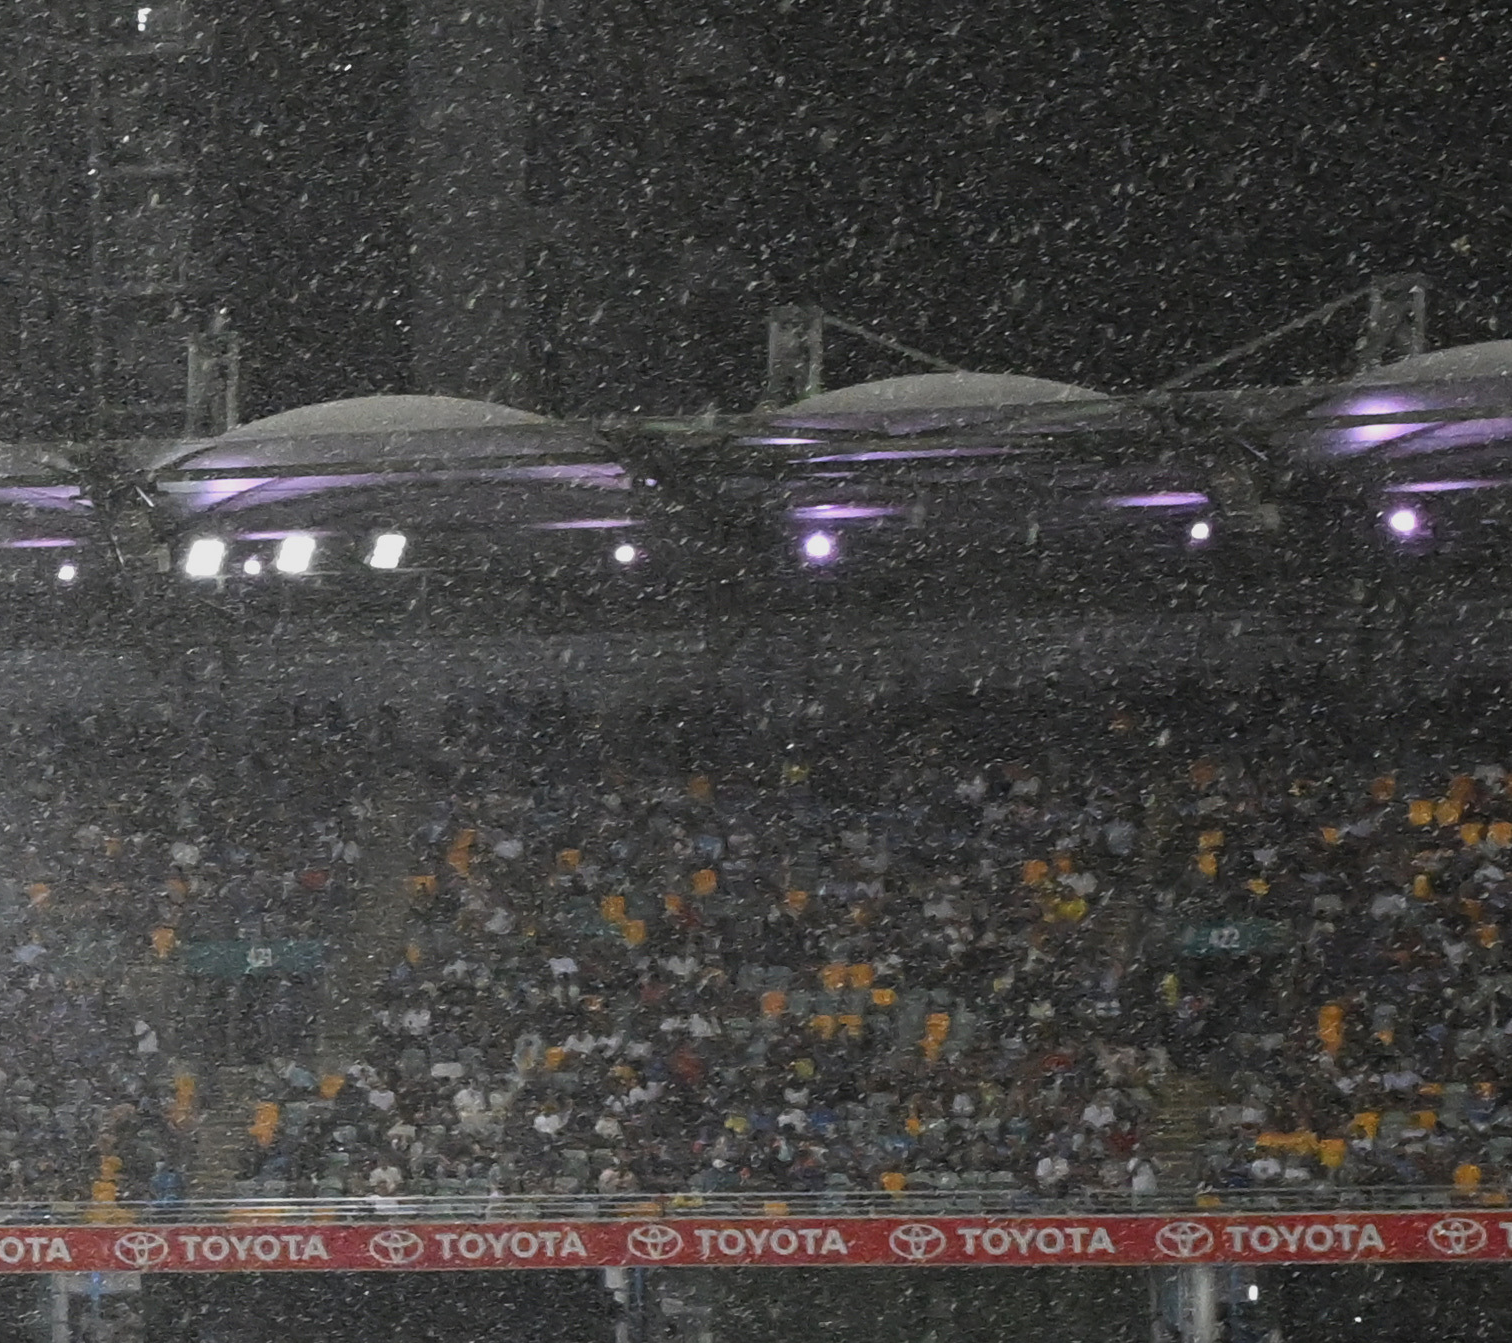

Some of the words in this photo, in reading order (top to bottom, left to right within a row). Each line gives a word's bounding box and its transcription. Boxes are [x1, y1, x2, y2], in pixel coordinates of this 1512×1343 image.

[180, 1236, 327, 1261] TOYOTA
[436, 1232, 586, 1258] TOYOTA
[695, 1229, 846, 1254] TOYOTA
[959, 1228, 1113, 1254] TOYOTA
[1227, 1225, 1382, 1251] TOYOTA
